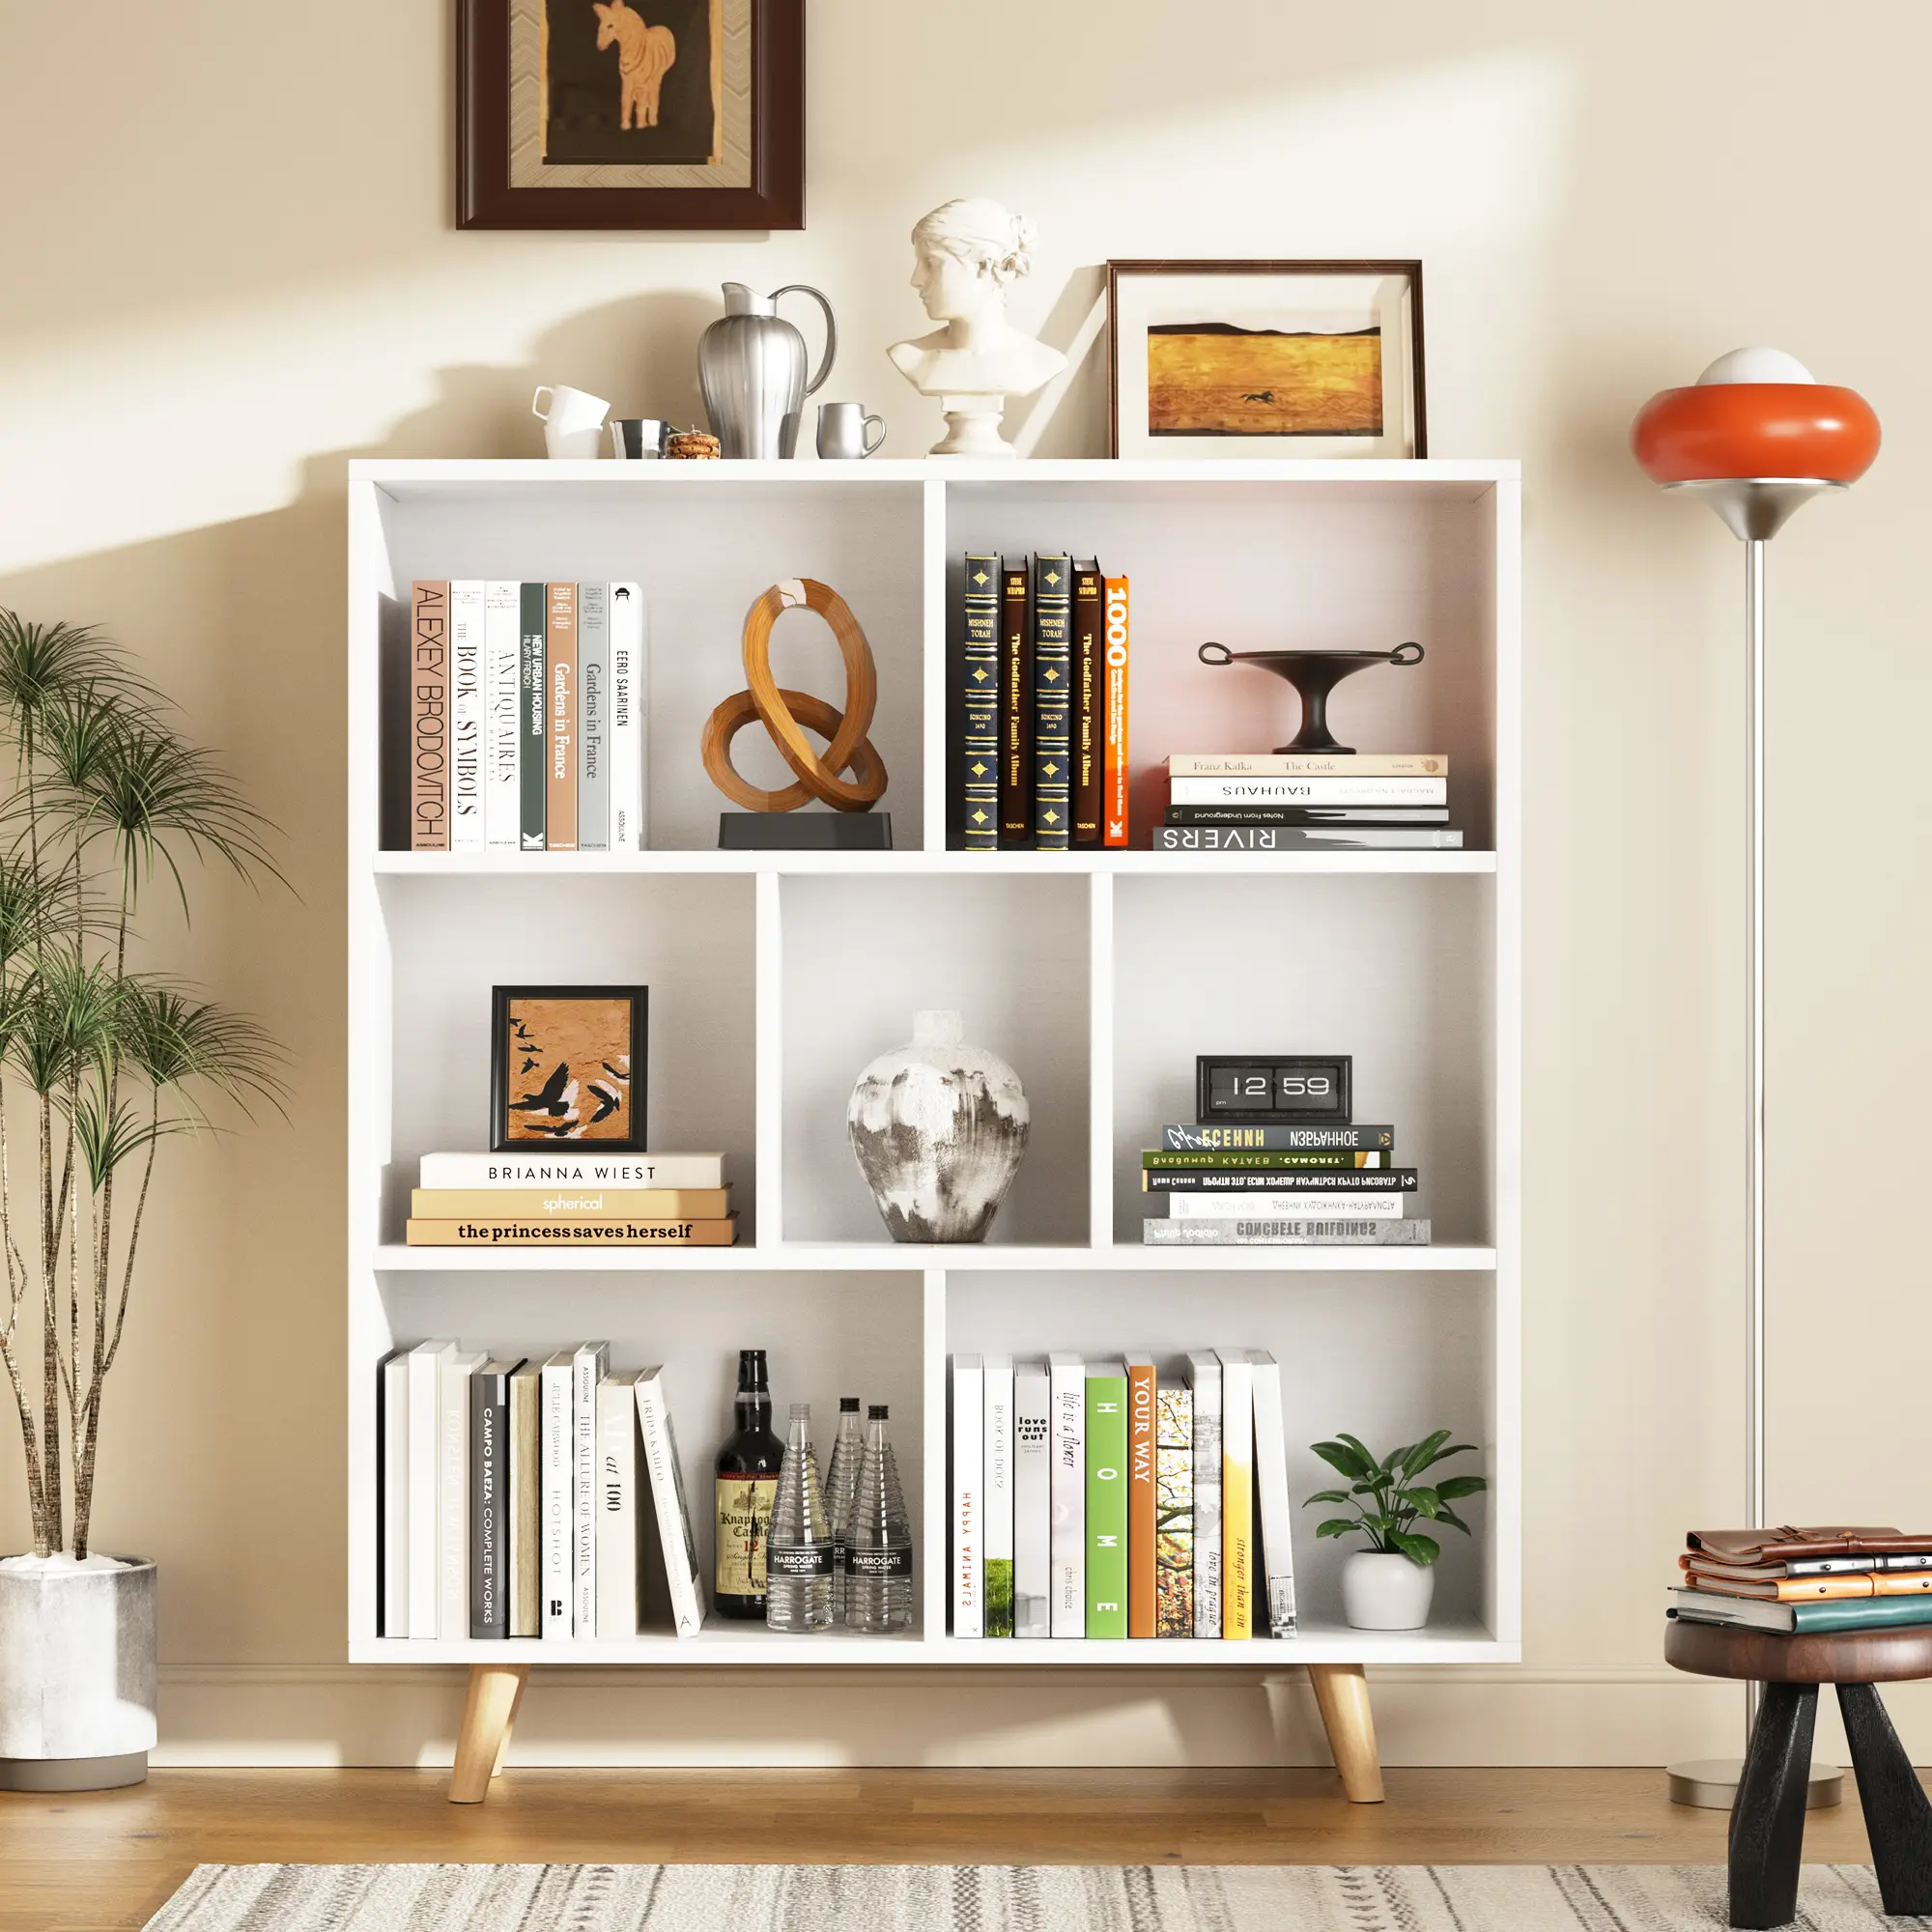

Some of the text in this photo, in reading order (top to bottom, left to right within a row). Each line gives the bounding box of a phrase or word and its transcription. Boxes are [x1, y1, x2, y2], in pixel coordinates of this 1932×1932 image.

[968, 619, 994, 628] MISHNEH
[970, 629, 991, 639] TORAH
[1039, 619, 1065, 628] MISHNEH
[1042, 629, 1063, 639] TORAH
[1107, 587, 1127, 667] 1000
[457, 646, 478, 699] BOOK
[532, 635, 542, 736] NEW URBAN HOUSING
[617, 650, 628, 726] EERO SAARINEN
[416, 587, 444, 835] ALEXEY BRODOVITCH
[495, 650, 516, 783] ANTIQUAIRES
[554, 663, 570, 779] Gardens in France
[586, 663, 601, 779] Gardens in France
[1009, 634, 1020, 786] The Godfather Family Album
[1080, 634, 1092, 786] The Godfather Family Album
[457, 721, 478, 816] SYMBOLS
[1194, 761, 1252, 771] Franz Kafka
[1222, 786, 1311, 796] BAUHAUS
[1284, 761, 1336, 771] The Castle
[1163, 829, 1276, 849] RIVERS
[1233, 1077, 1330, 1095] 12 59
[489, 1167, 656, 1179] BRIANNA WIEST
[543, 1194, 603, 1215] spherical
[458, 1224, 693, 1242] the princess saves herself
[1056, 1392, 1080, 1408] life
[1063, 1413, 1077, 1421] is
[643, 1399, 664, 1481] FRIDA KAHLO
[1056, 1434, 1080, 1468] flower
[1135, 1378, 1151, 1483] YOUR WAY
[580, 1415, 590, 1576] THE ALLURE OF WOMEN
[606, 1457, 622, 1511] at 100
[1096, 1402, 1118, 1612] HOME
[483, 1408, 493, 1623] CAMPO BAEZA: COMPLETE WORKS
[552, 1491, 561, 1576] HOTSHOT
[744, 1541, 758, 1552] 12
[774, 1556, 823, 1564] HARROGATE
[1065, 1567, 1077, 1609] chris choice
[1205, 1551, 1220, 1625] love in prague
[1233, 1538, 1249, 1628] stronger than sin
